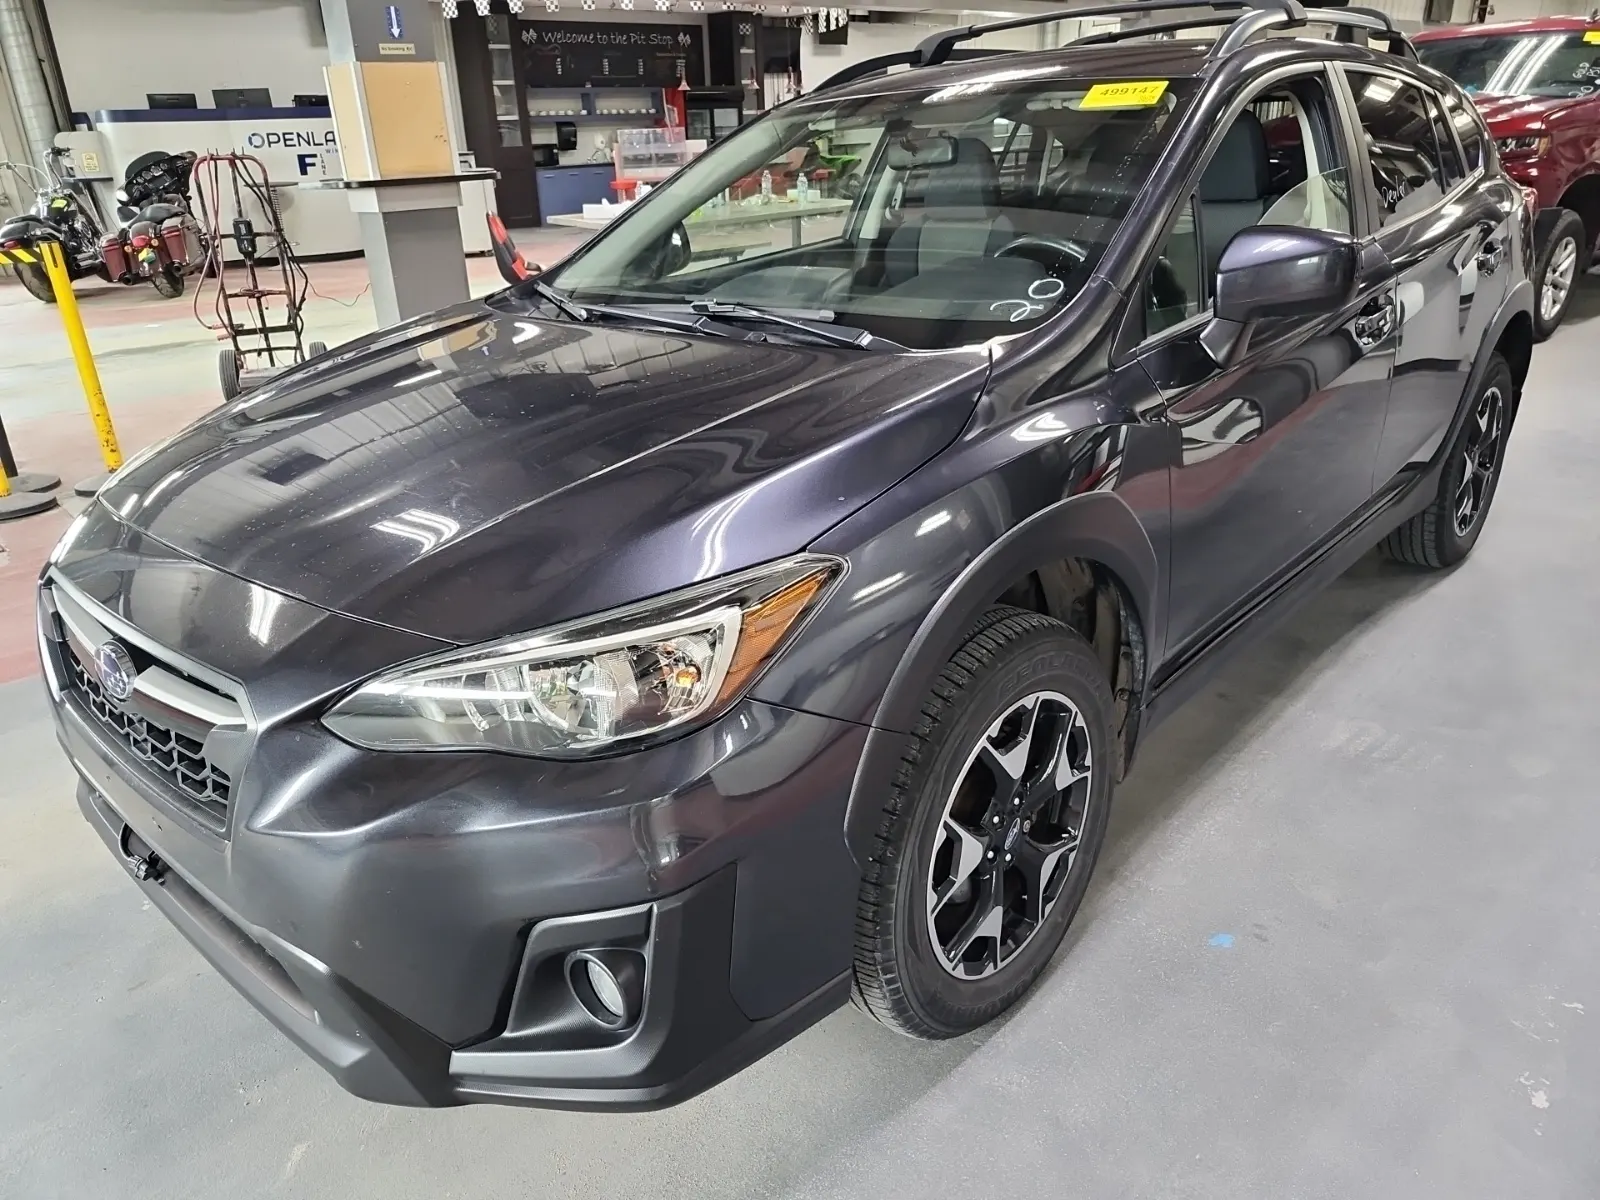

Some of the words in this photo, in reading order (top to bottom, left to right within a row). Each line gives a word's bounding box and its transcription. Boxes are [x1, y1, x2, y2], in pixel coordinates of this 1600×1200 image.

[542, 30, 595, 44] Welcome
[597, 31, 608, 44] to
[610, 32, 628, 45] the
[629, 33, 647, 45] Pit
[649, 34, 674, 49] Stop
[1099, 86, 1160, 97] 499147
[297, 153, 318, 176] F
[989, 278, 1065, 323] 20
